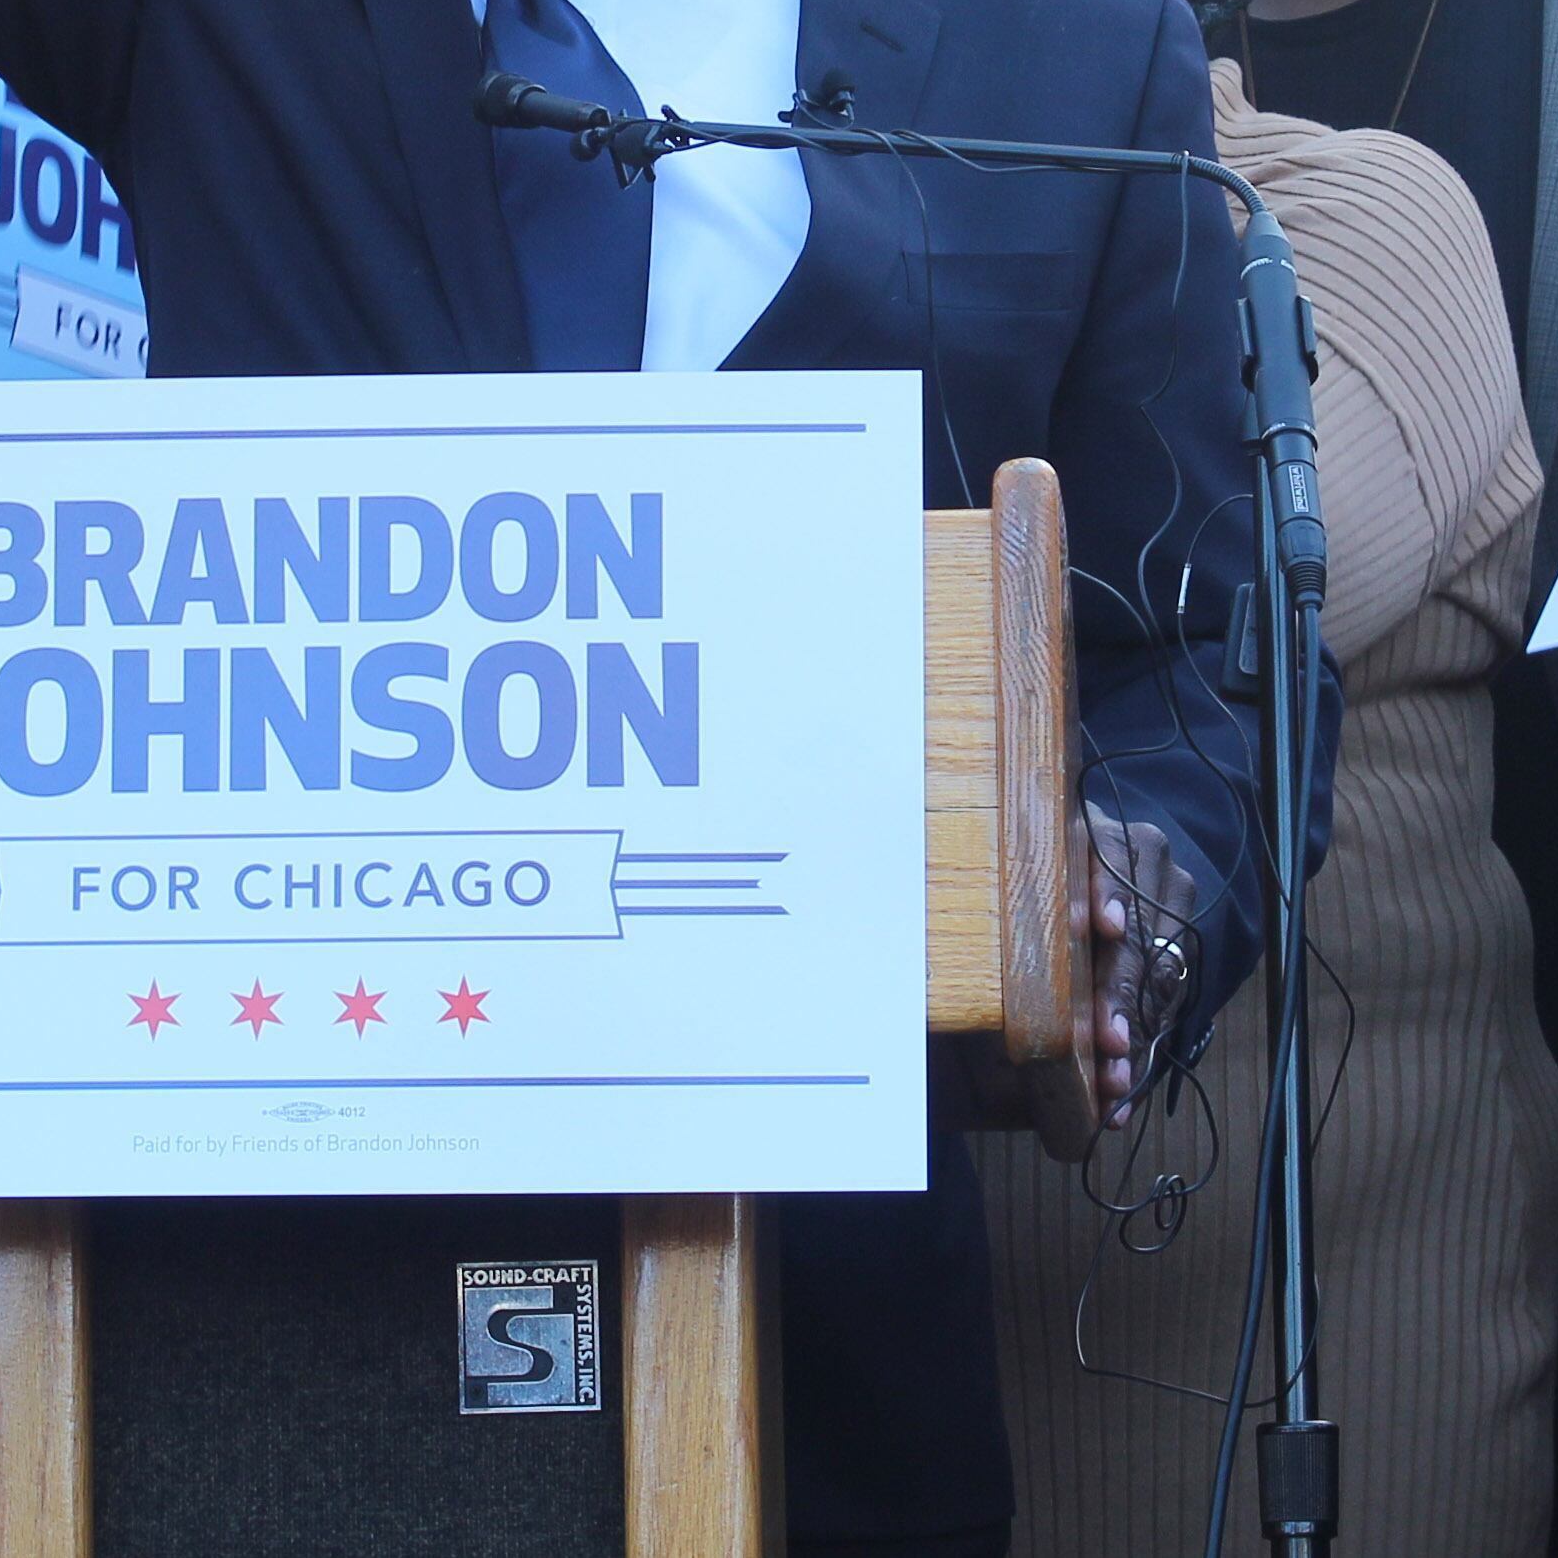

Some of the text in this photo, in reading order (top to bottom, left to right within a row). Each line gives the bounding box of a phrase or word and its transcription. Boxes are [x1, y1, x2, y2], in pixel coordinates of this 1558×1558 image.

[54, 304, 122, 359] FOR
[71, 858, 553, 913] FOR CHICAGO
[338, 1106, 366, 1118] 4012
[132, 1133, 480, 1157] Paid for by Friends of Brandon Johnson
[463, 1267, 591, 1286] SOUND-CRAFT
[576, 1284, 595, 1403] SYSTEMS, INC.
